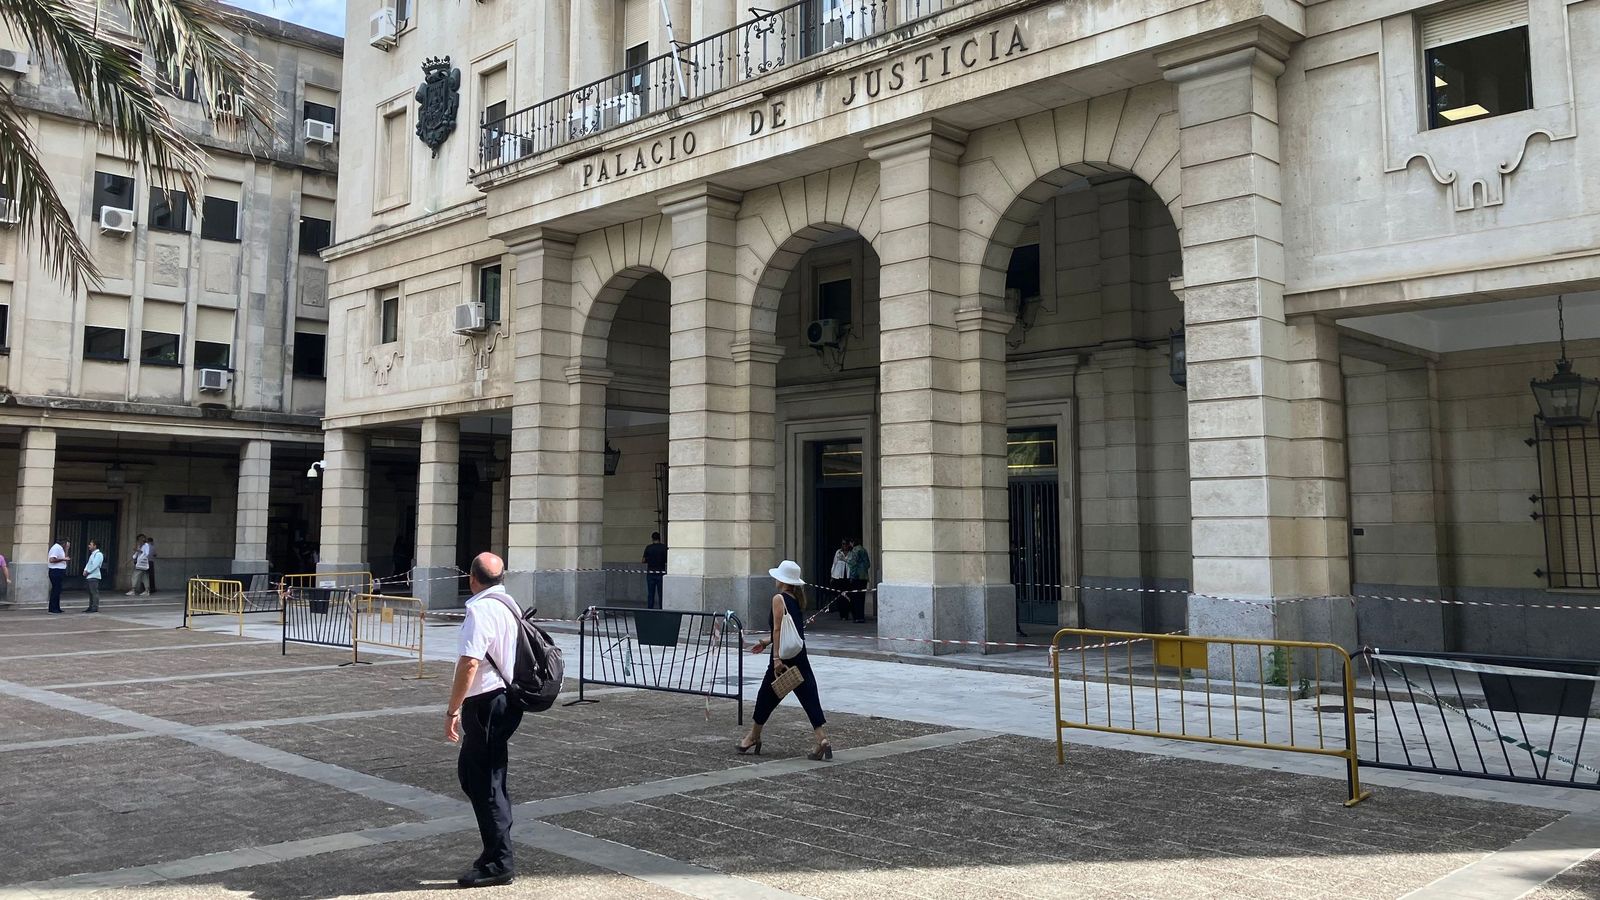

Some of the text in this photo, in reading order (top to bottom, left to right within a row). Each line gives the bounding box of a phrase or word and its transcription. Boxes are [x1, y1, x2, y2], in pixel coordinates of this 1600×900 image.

[583, 23, 1029, 187] PALACIO DE JUSTICIA
